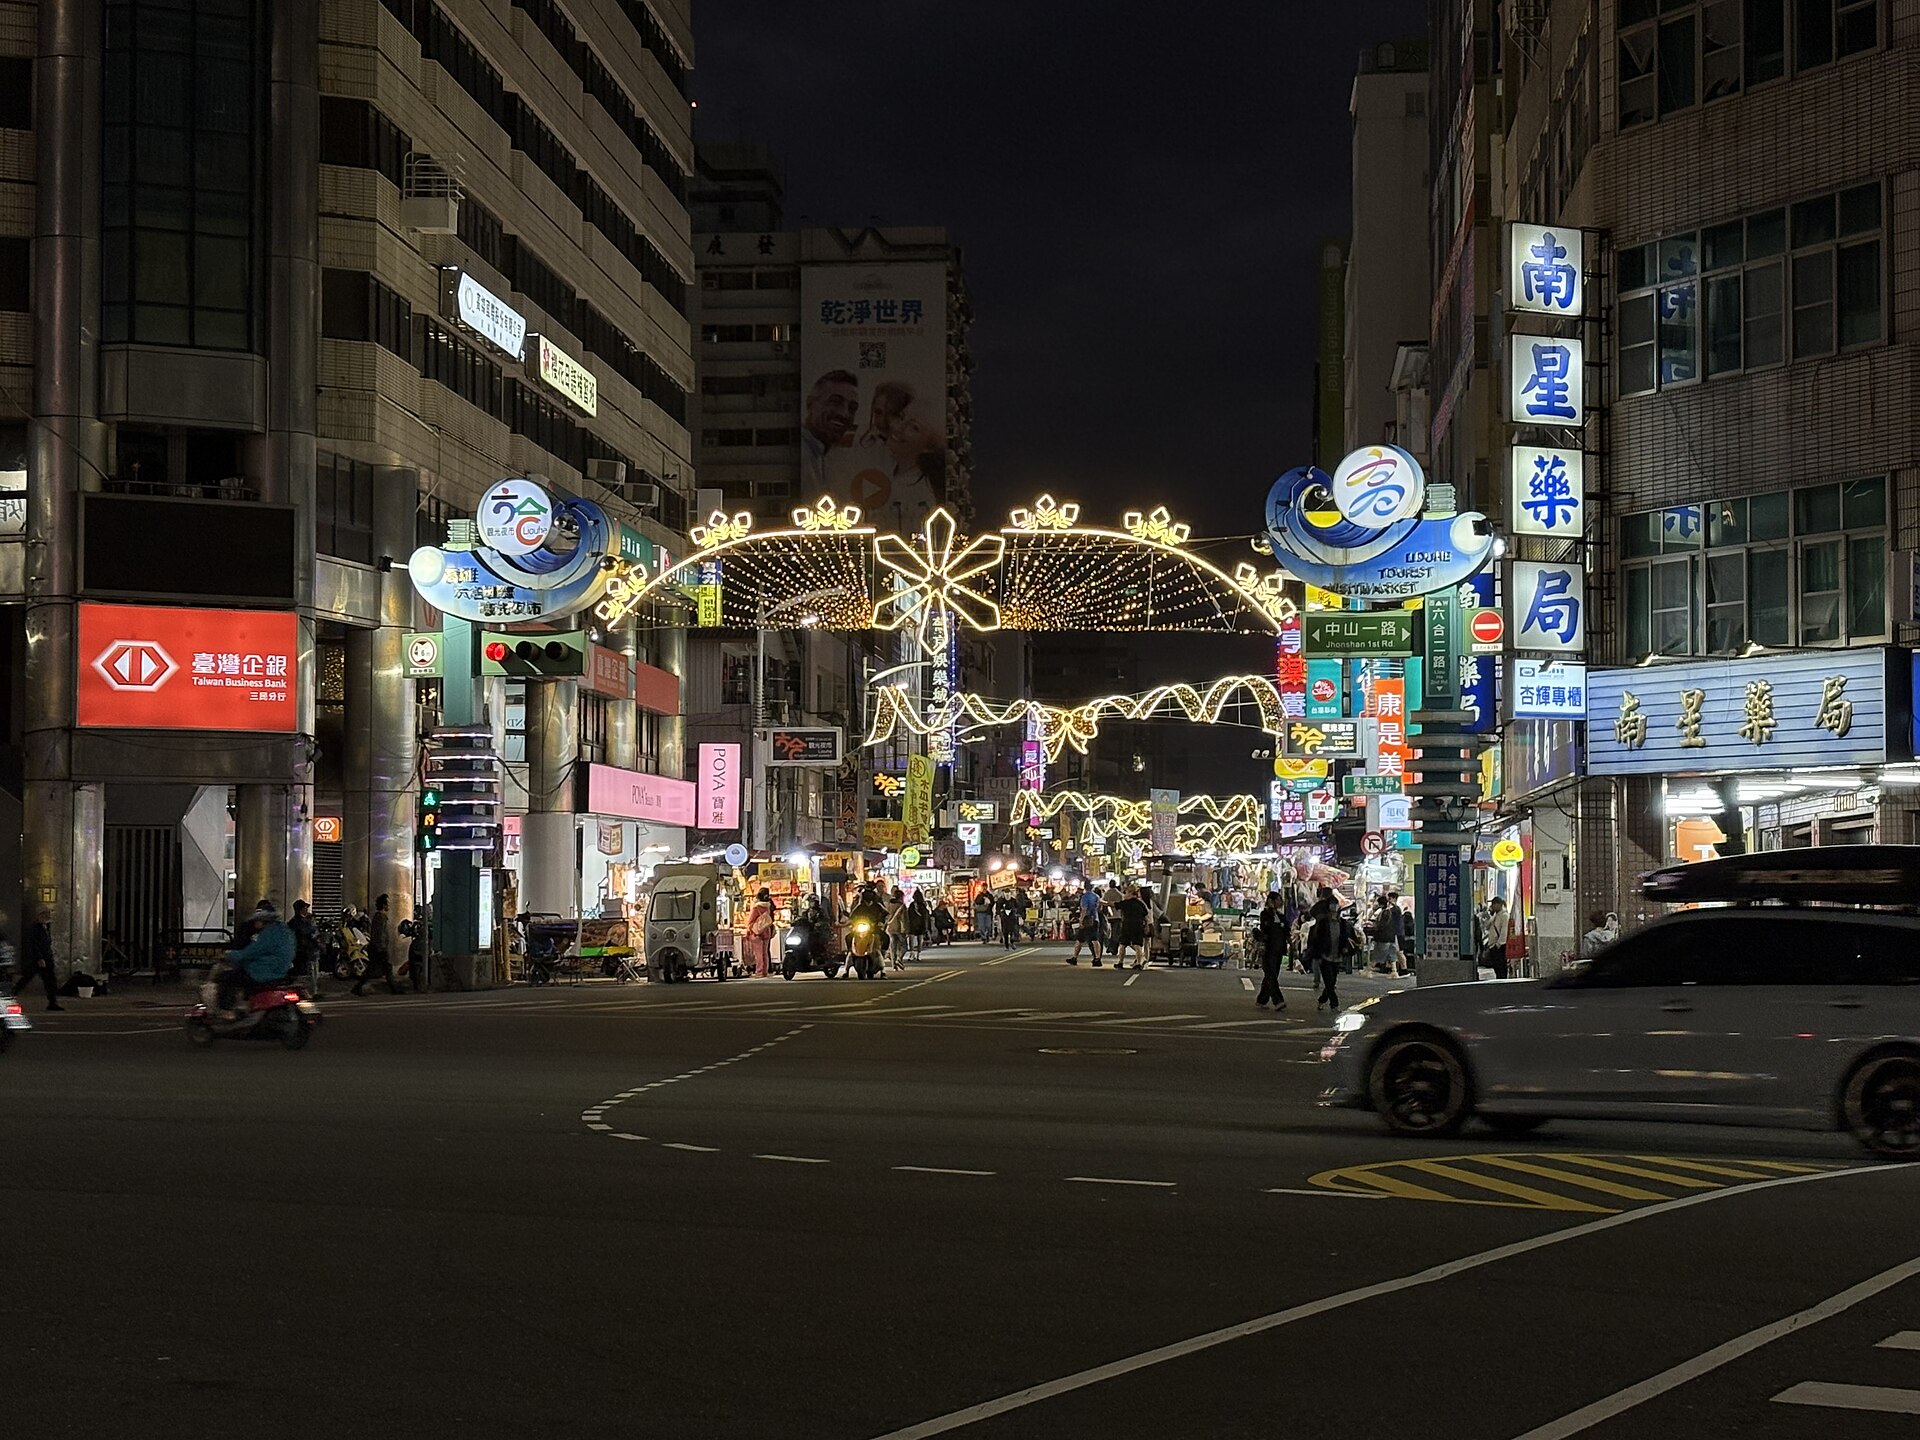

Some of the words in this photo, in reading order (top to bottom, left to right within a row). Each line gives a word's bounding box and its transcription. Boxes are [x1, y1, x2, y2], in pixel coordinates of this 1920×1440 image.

[820, 299, 924, 325] 乾淨世界
[1521, 231, 1581, 644] 南星藥局
[1325, 621, 1396, 637] 中山一路
[1432, 608, 1446, 668] 六合二路
[1326, 640, 1366, 649] Jhonshan
[1368, 640, 1380, 648] 1st
[191, 652, 287, 676] 臺灣企銀
[192, 677, 224, 687] Taiwan
[225, 678, 263, 687] Business
[265, 679, 287, 689] Bank
[249, 691, 287, 701] 三民分行
[1520, 685, 1583, 707] 杏輝專櫃
[1377, 693, 1403, 776] 康是美
[712, 747, 726, 791] POYA
[711, 796, 725, 825] 寶雅
[1428, 853, 1438, 925] 招呼站
[1438, 853, 1447, 925] 臨時計程車
[1448, 854, 1458, 925] 六合夜市
